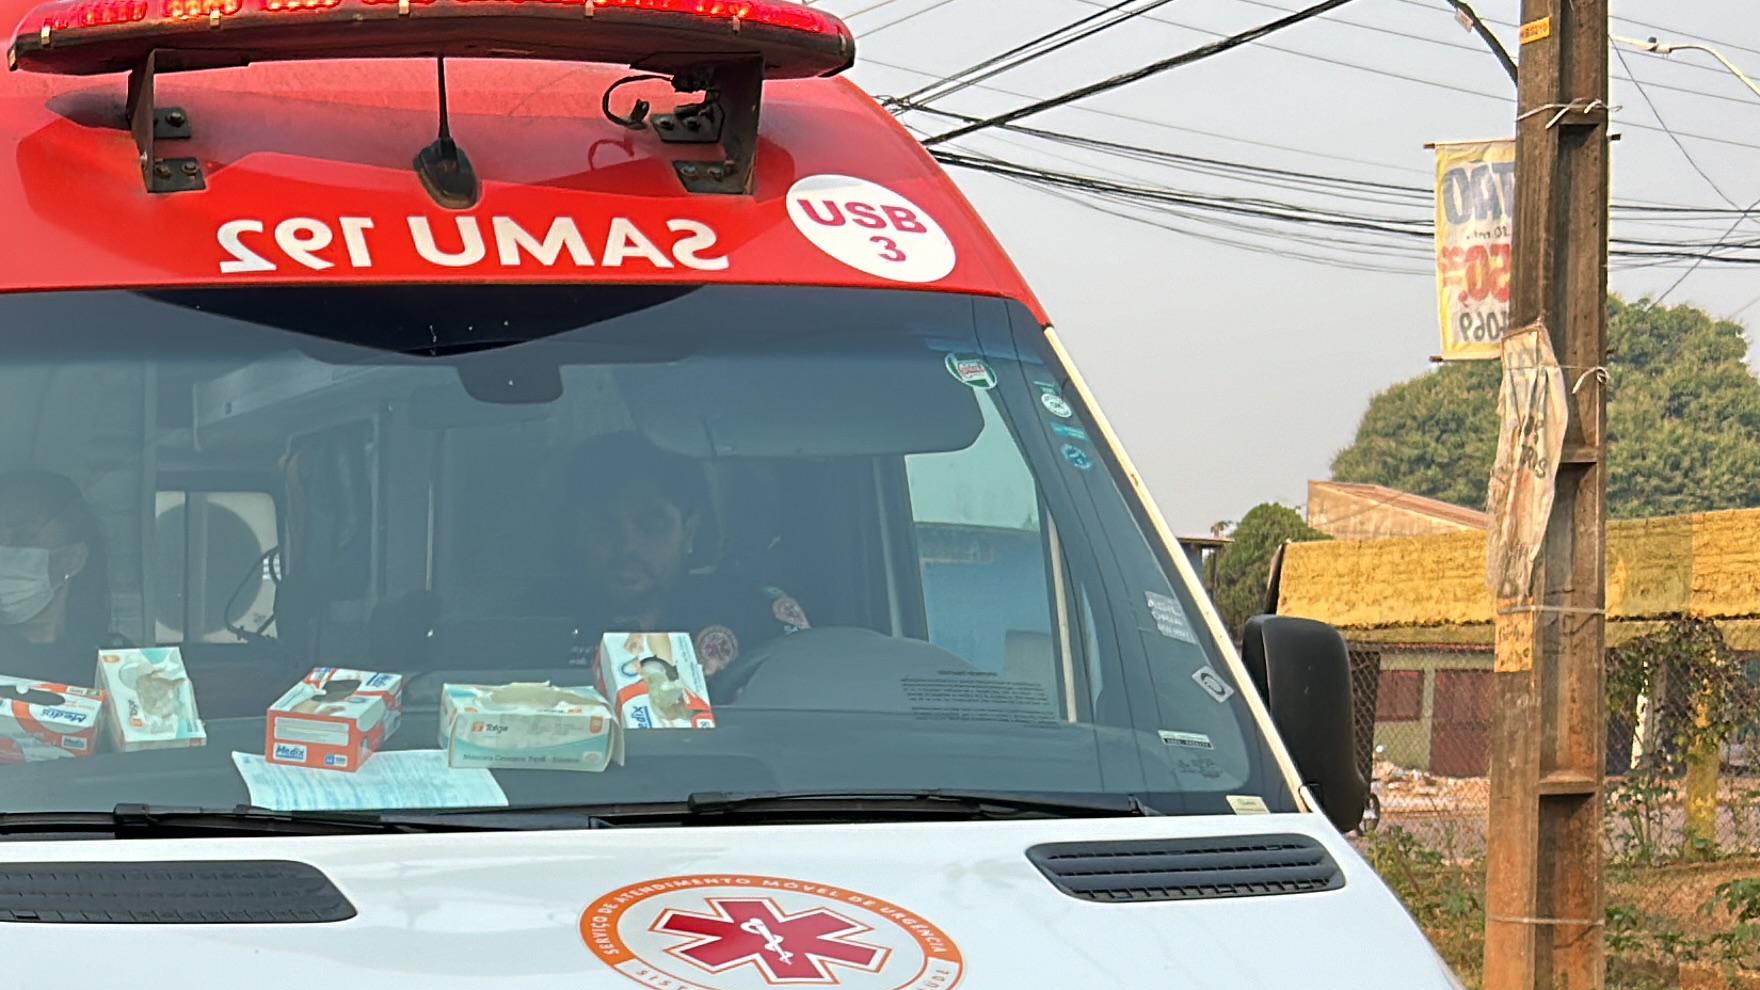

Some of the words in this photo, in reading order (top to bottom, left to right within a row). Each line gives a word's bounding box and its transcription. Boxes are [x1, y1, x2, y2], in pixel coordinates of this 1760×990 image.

[796, 199, 928, 234] USB
[870, 235, 907, 263] 3
[615, 877, 751, 907] ATENDIMENTO
[762, 878, 839, 897] MÓVEL
[848, 892, 874, 907] DE
[602, 902, 619, 916] DE
[595, 917, 620, 956] SERVIÇO
